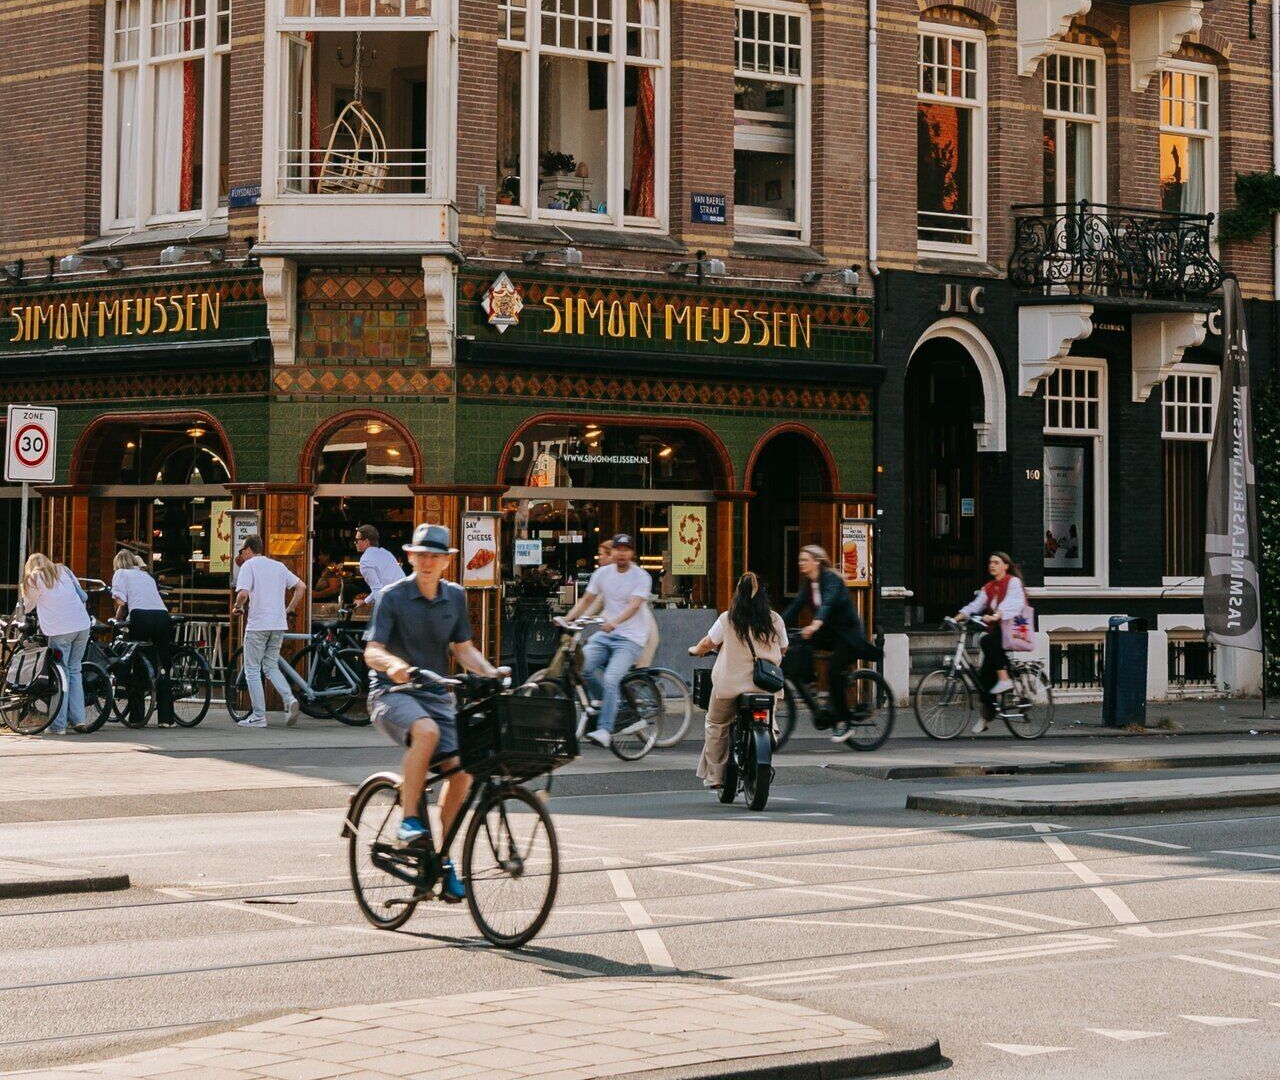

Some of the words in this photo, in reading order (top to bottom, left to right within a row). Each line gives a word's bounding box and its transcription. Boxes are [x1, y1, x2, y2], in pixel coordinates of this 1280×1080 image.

[694, 195, 705, 203] VAN
[706, 196, 725, 206] BAERLE
[700, 206, 720, 215] STRAAT
[940, 283, 985, 315] JLC
[10, 302, 89, 342] SIMON
[98, 292, 220, 338] MEIJSSEN
[542, 296, 652, 339] SIMON
[665, 304, 811, 349] MEIJSSEN
[23, 412, 44, 420] ZONE
[21, 437, 44, 452] 30
[563, 454, 651, 465] WWW.SIMONMEIJSSEN.NL
[1025, 469, 1040, 480] 160
[466, 521, 477, 529] SAY
